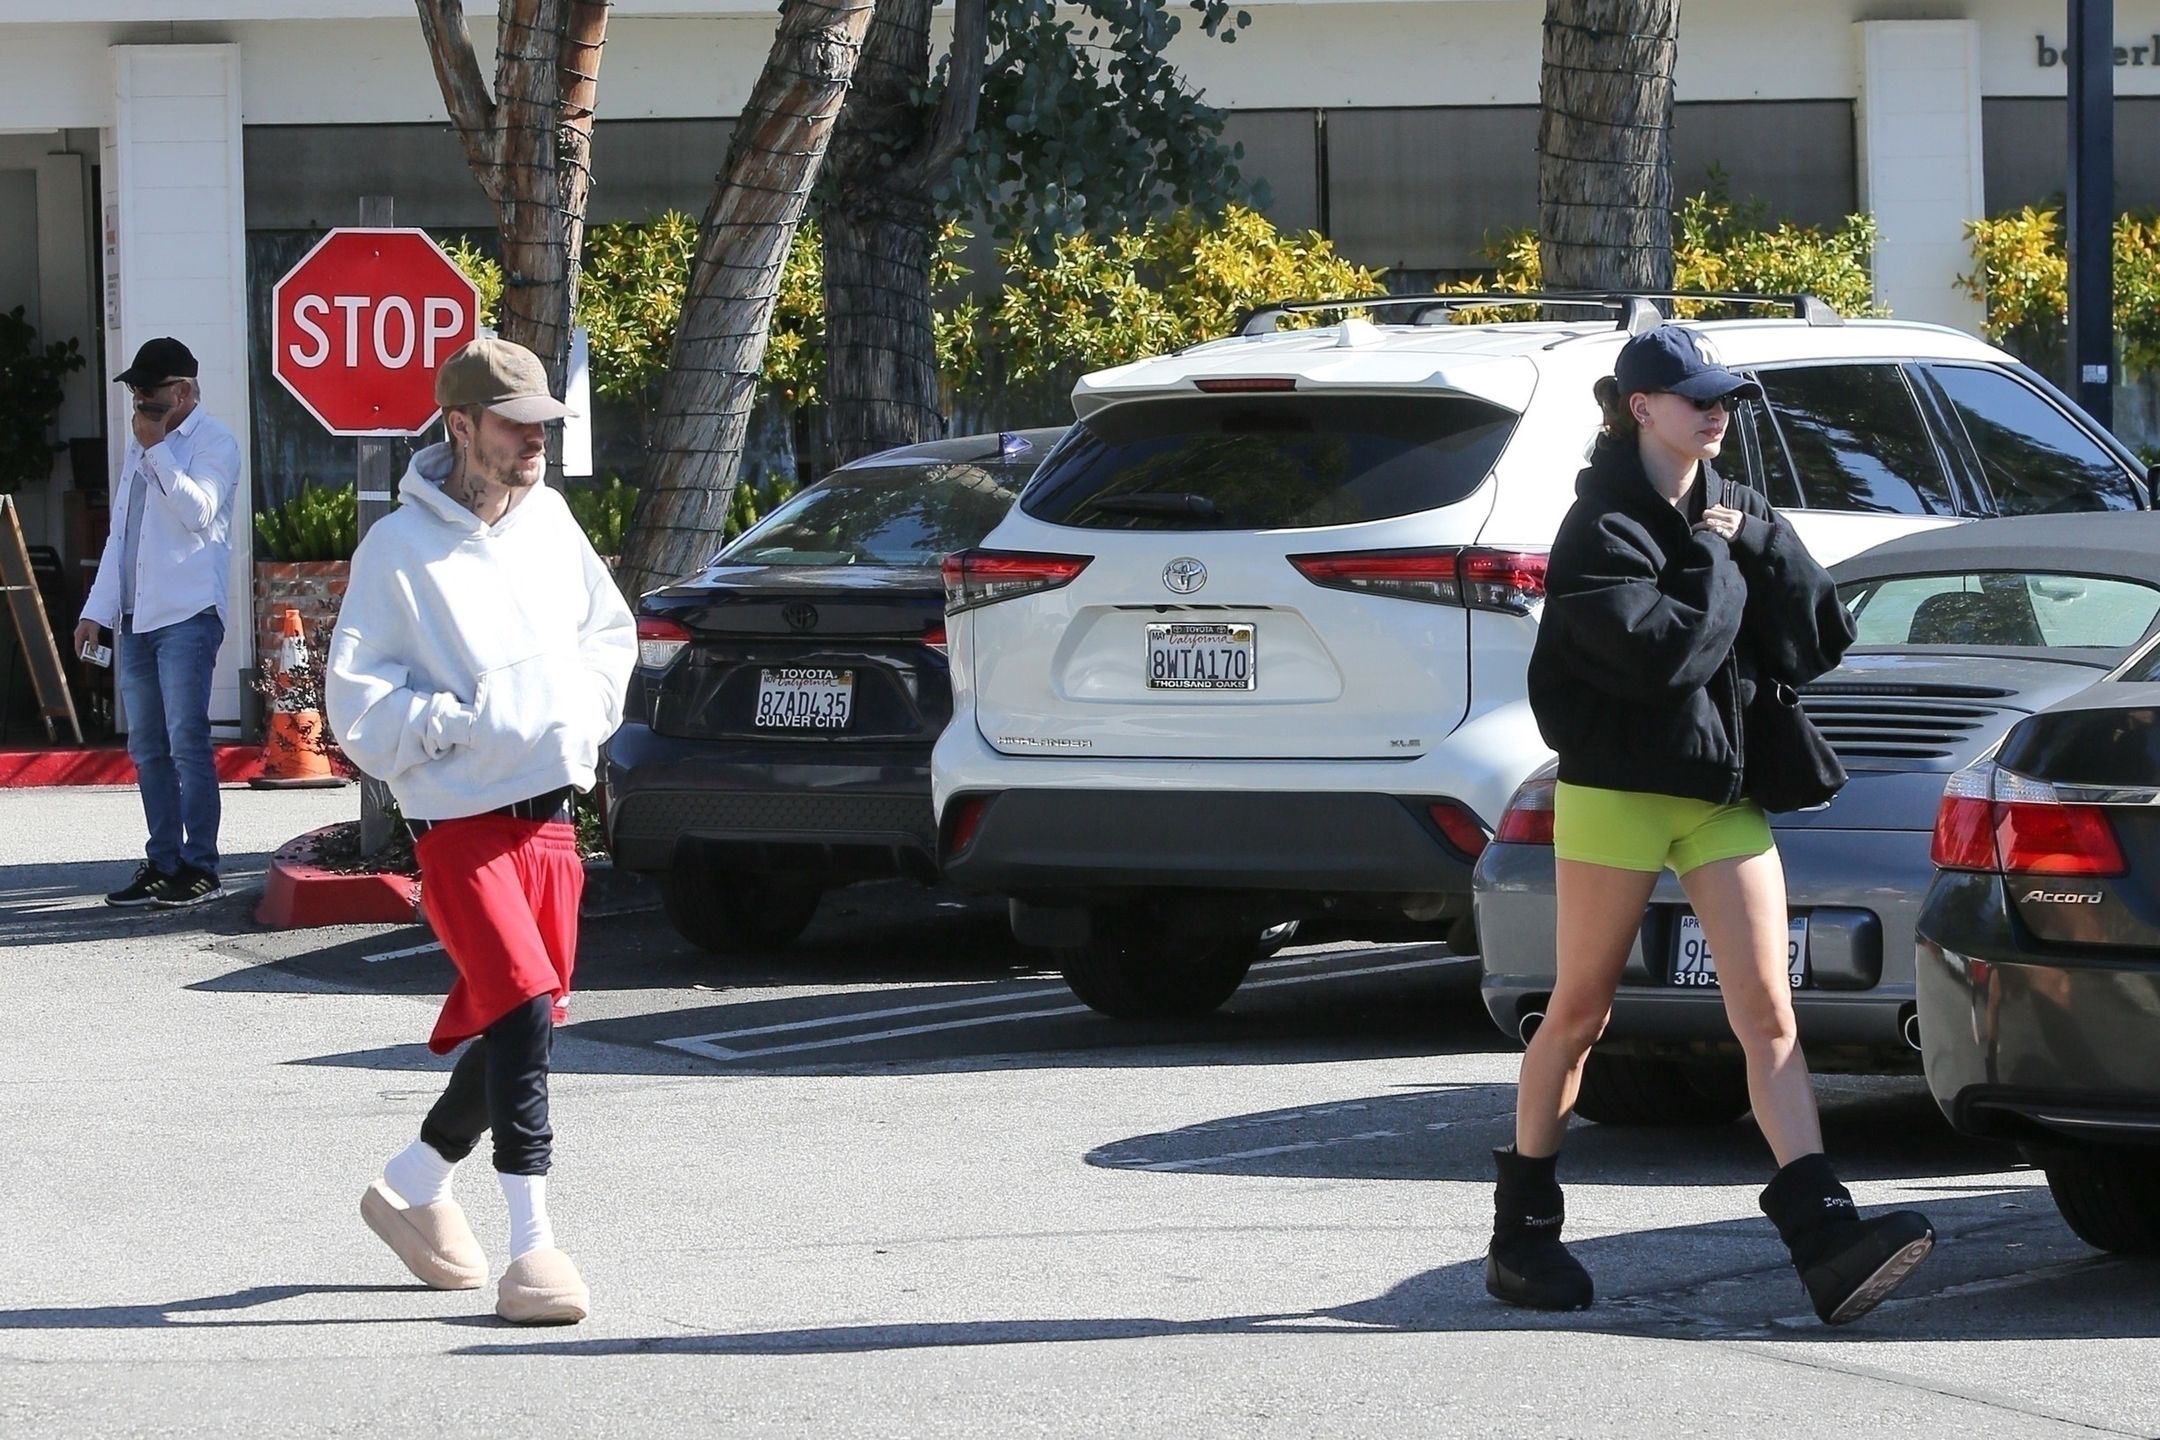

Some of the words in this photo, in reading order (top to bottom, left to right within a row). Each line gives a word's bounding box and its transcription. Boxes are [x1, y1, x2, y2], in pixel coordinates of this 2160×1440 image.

[289, 294, 464, 369] STOP
[1152, 632, 1166, 640] MAY
[1169, 633, 1234, 649] California
[1153, 649, 1246, 680] 8WTA170
[1155, 680, 1212, 688] THOUSAND
[760, 691, 846, 717] 8ZAD435
[755, 715, 811, 727] CULVER
[815, 716, 848, 728] CITY
[997, 736, 1093, 747] HIGHLANDER
[2020, 890, 2103, 904] Accord
[1683, 918, 1700, 928] APR
